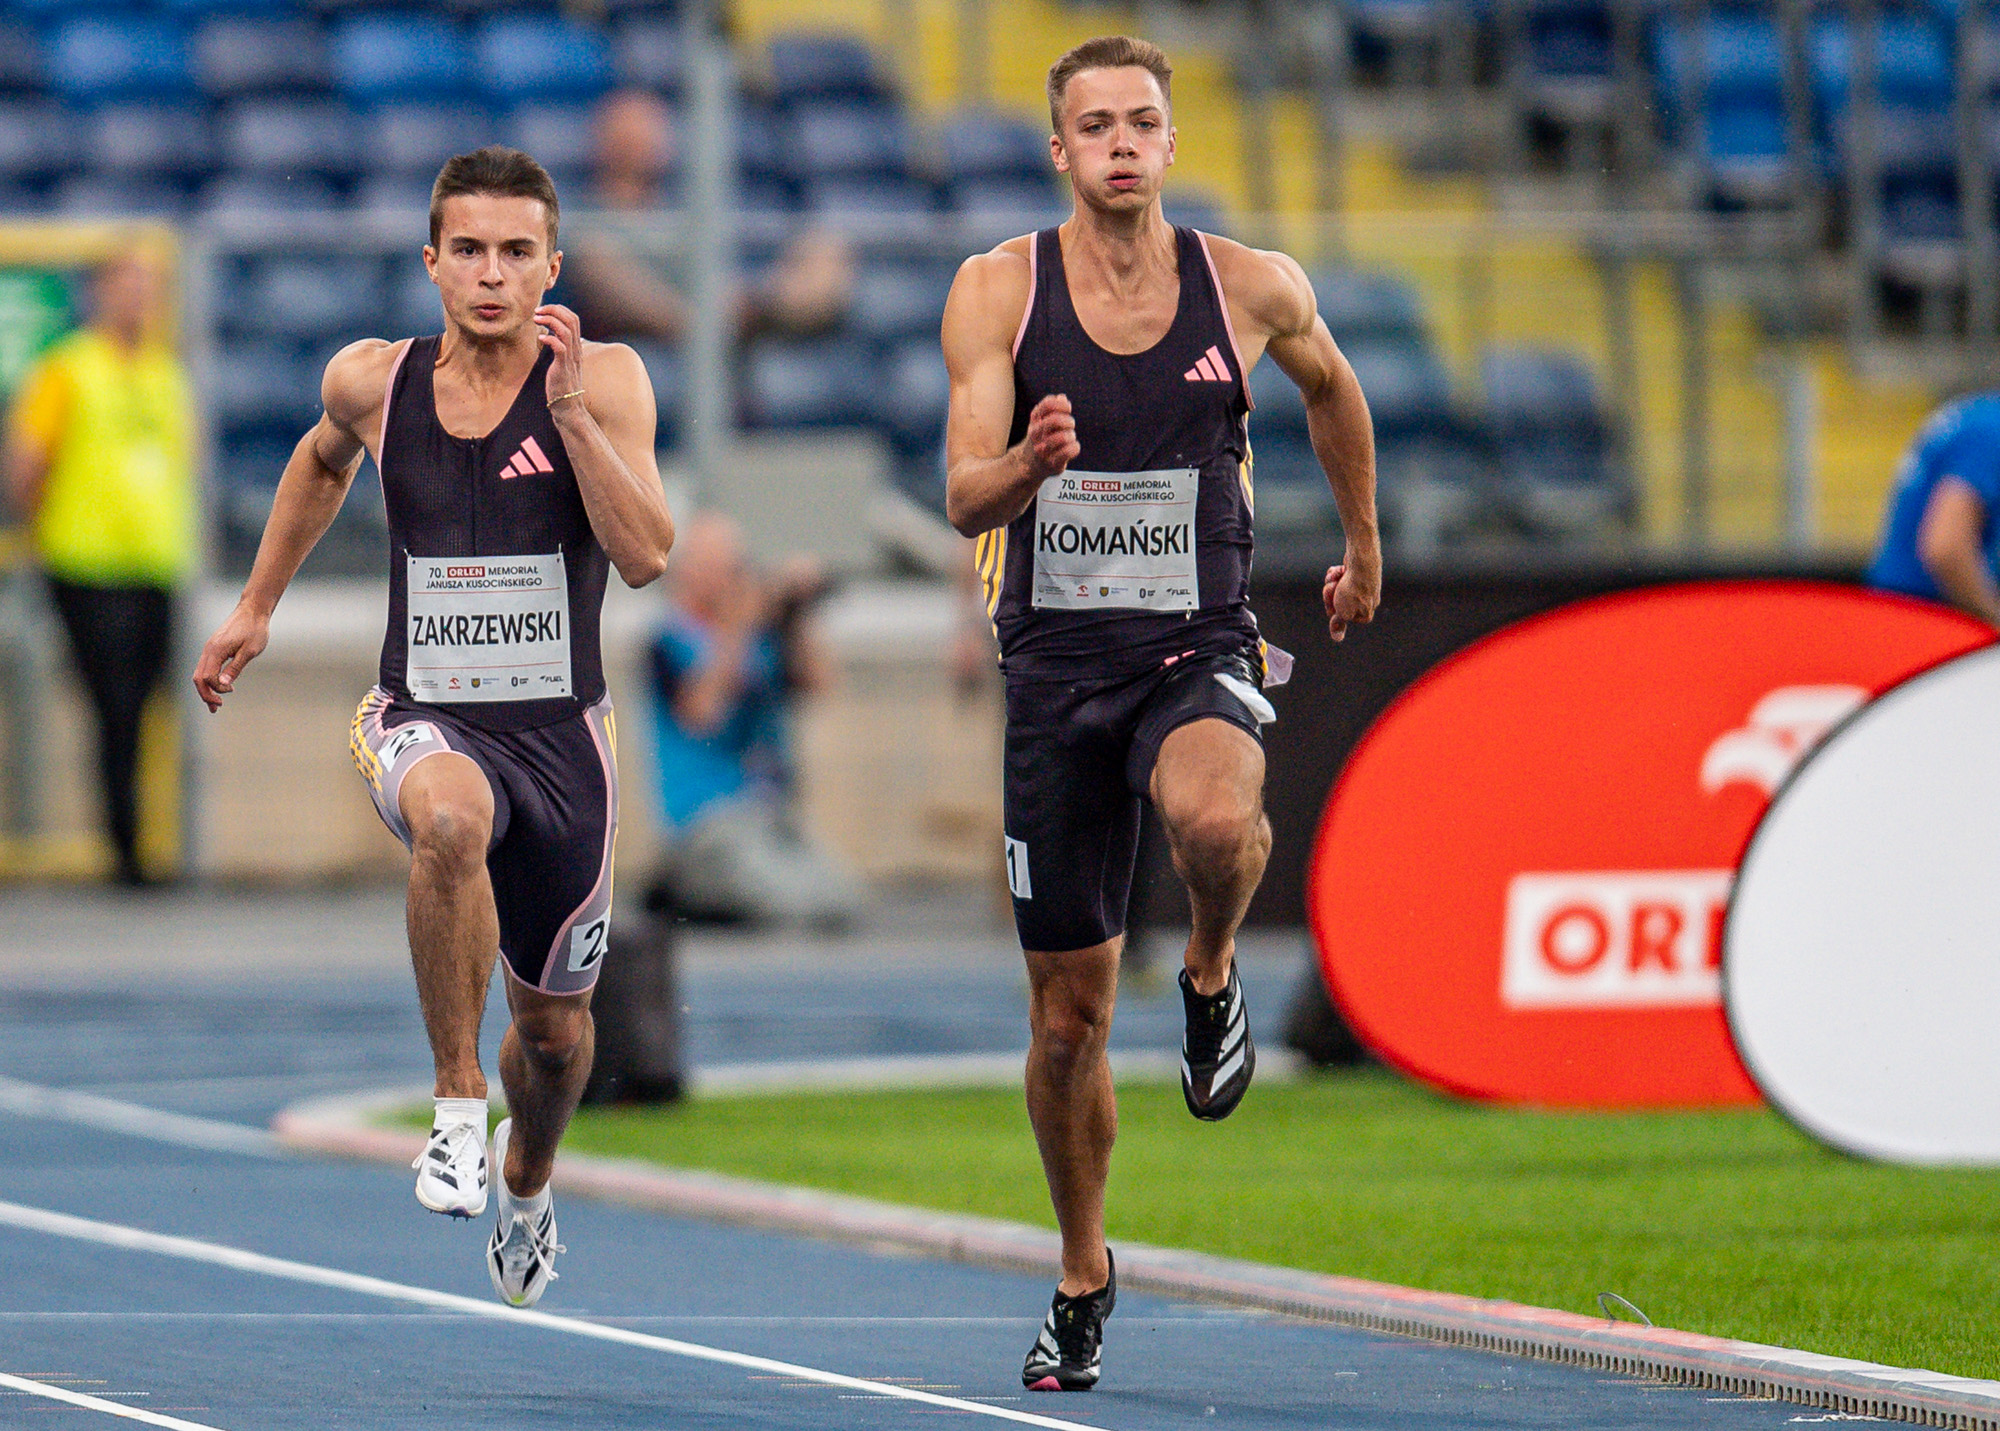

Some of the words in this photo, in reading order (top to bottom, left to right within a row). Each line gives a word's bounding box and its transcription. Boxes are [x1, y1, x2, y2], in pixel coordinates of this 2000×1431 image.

[1058, 491, 1098, 502] JANUSZA
[1100, 490, 1175, 502] KUSOCIŃSKIEGO
[1062, 480, 1078, 490] 70.
[1083, 481, 1120, 491] ORLEN
[1124, 480, 1172, 490] MEMORIAŁ
[1039, 519, 1189, 556] KOMAŃSKI
[426, 579, 463, 589] JANUSZA
[466, 577, 542, 588] KUSOCIŃSKIEGO
[428, 567, 444, 578] 70.
[448, 568, 484, 578] ORLEN
[488, 566, 538, 576] MEMORIAŁ
[412, 610, 561, 646] ZAKRZEWSKI
[393, 728, 419, 758] 2
[1006, 842, 1018, 893] 1
[580, 920, 606, 968] 2
